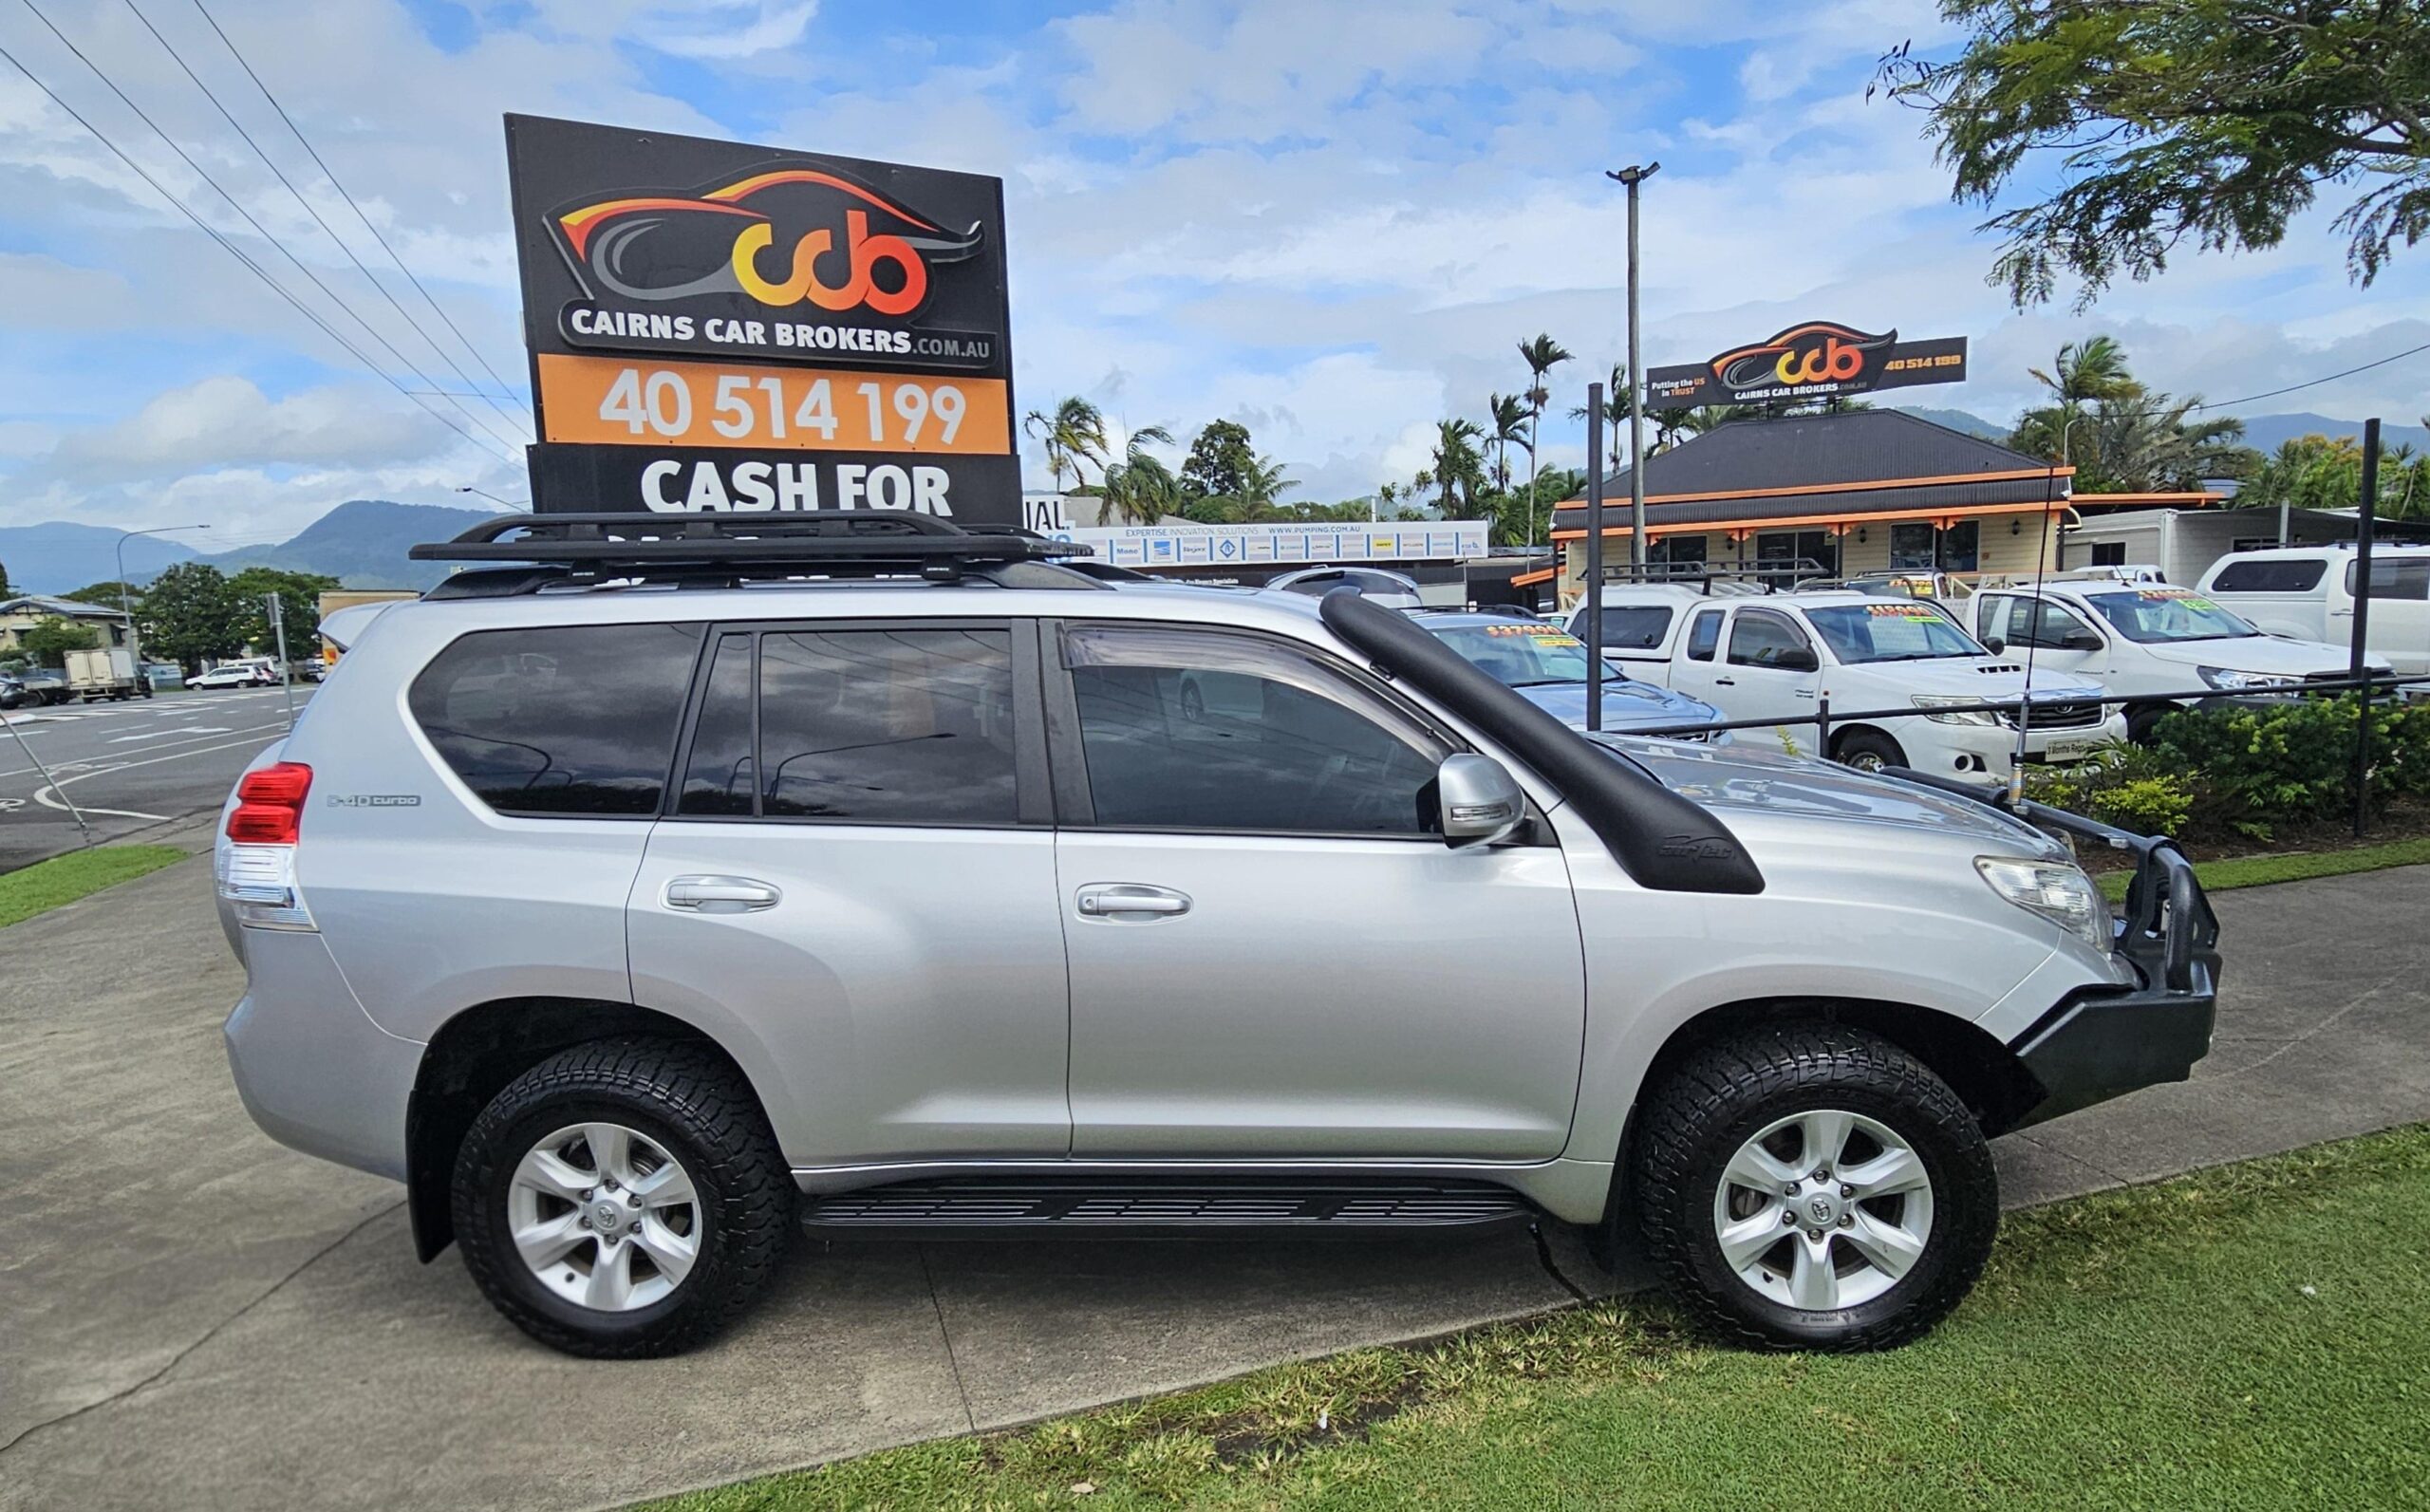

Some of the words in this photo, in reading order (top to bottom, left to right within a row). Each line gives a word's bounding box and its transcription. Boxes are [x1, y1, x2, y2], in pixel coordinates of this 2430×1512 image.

[570, 308, 695, 341] CAIRNS
[704, 318, 767, 345] CAR
[775, 323, 991, 360] BROKERS.COM.AU
[1884, 360, 1905, 371] 40
[1906, 357, 1933, 369] 514
[1935, 354, 1962, 366] 199
[1652, 381, 1680, 390] Putting
[1680, 379, 1693, 387] the
[1694, 377, 1706, 385] US
[1671, 386, 1695, 396] TRUST
[1734, 389, 1770, 400] CAIRNS
[1771, 387, 1791, 397] CAR
[599, 368, 693, 438] 40
[711, 375, 838, 441] 514
[856, 383, 967, 445] 199
[641, 459, 818, 513] CASH
[837, 465, 953, 517] FOR
[1126, 529, 1168, 537] EXPERTISE
[1217, 527, 1259, 535] SOLUTIONS
[1268, 526, 1361, 534] WWW.PUMPING.COM.AU
[327, 794, 371, 808] D-4D
[372, 795, 419, 806] turbo
